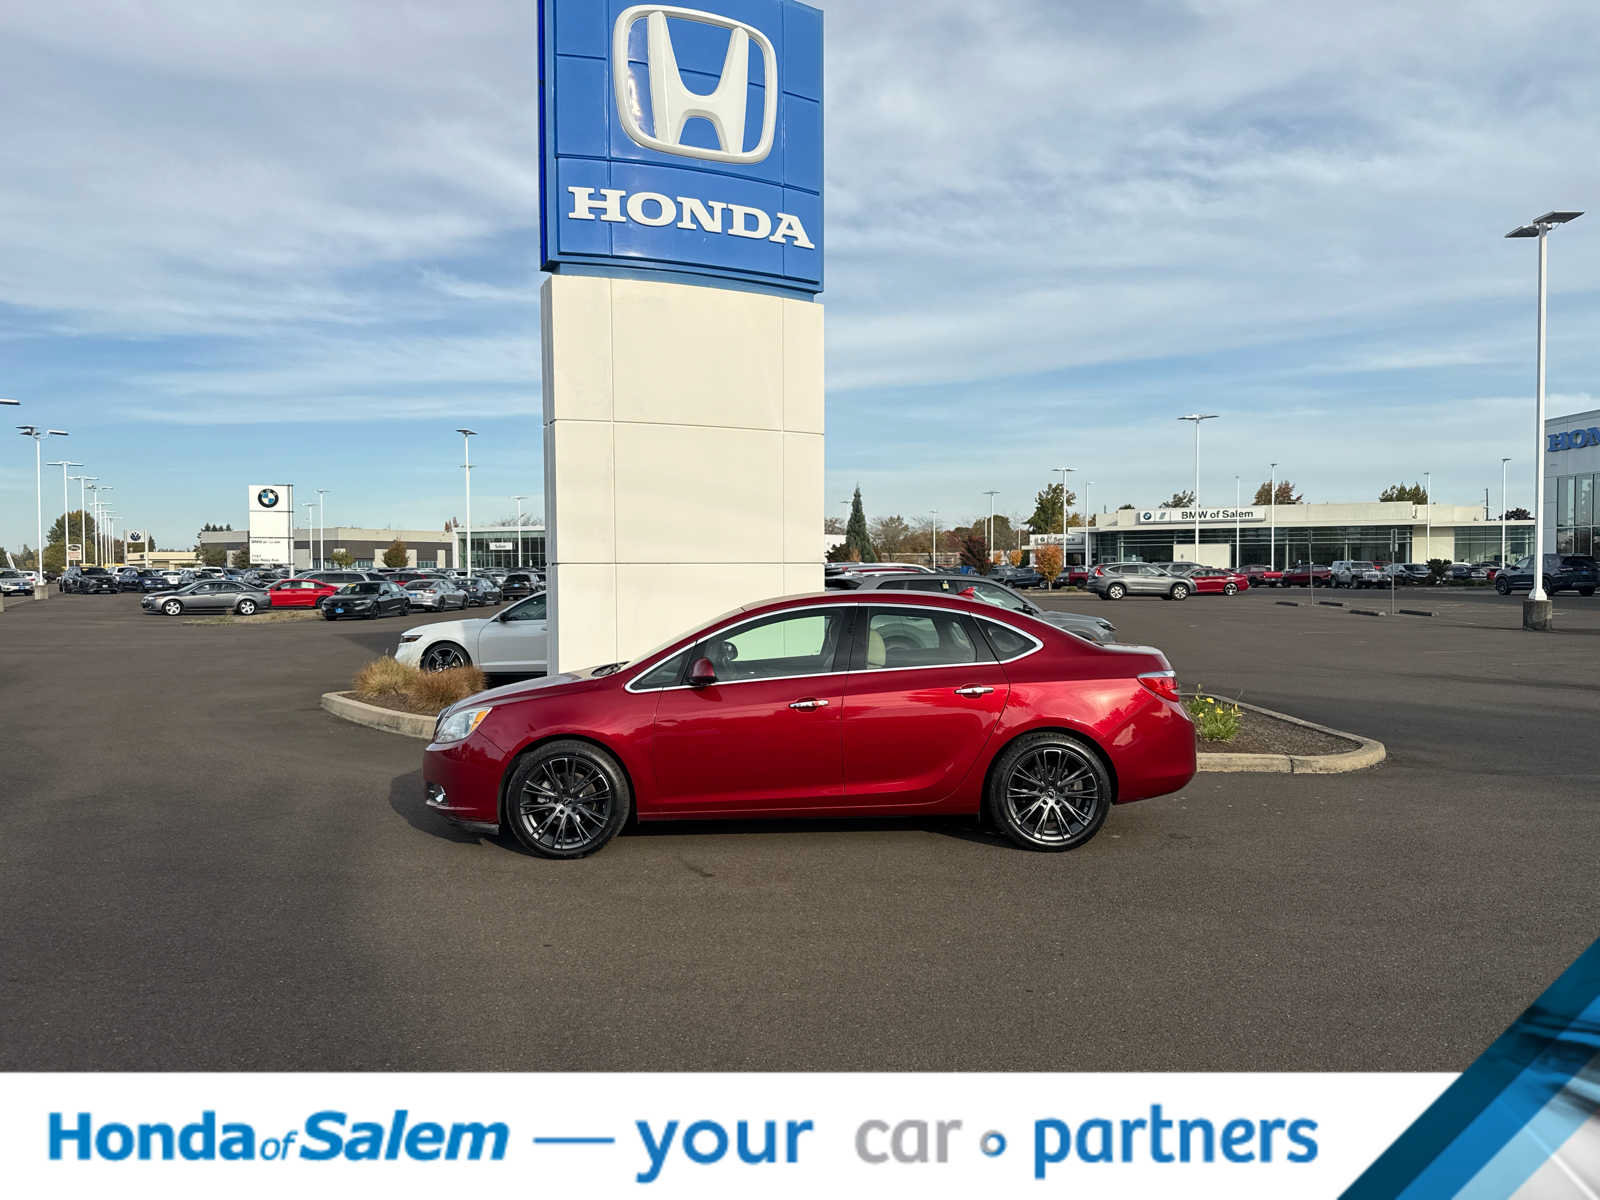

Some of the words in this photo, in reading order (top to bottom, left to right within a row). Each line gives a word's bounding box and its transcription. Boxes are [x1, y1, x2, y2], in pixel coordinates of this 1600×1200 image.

[567, 186, 815, 250] HONDA
[1181, 511, 1208, 520] BMW
[1210, 510, 1220, 519] of
[1222, 509, 1254, 519] Salem
